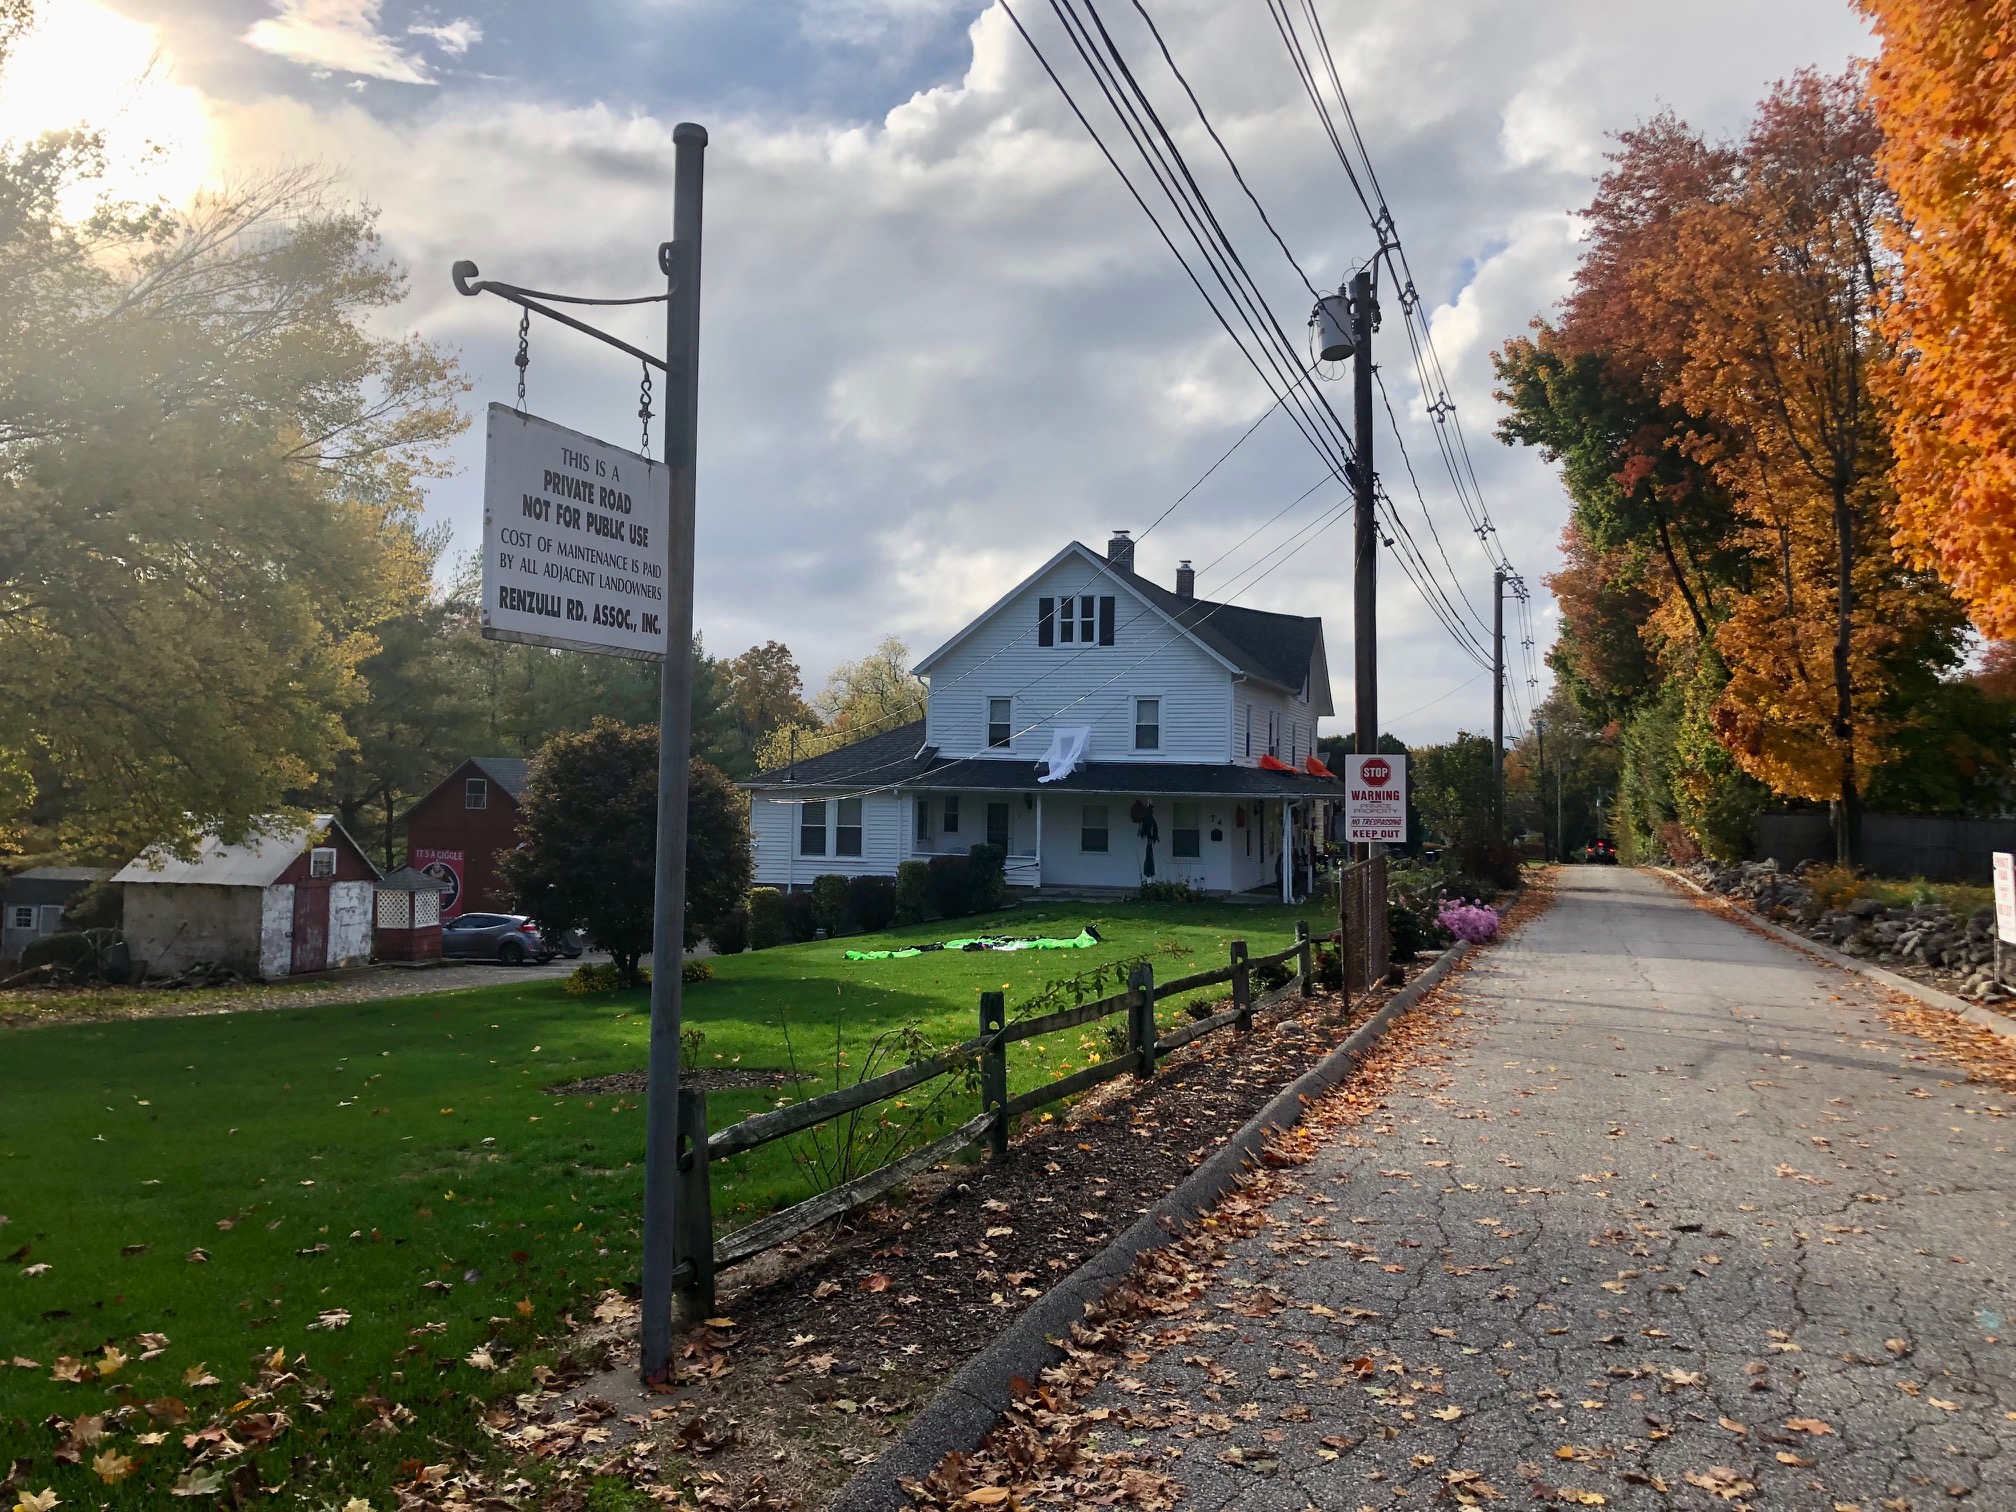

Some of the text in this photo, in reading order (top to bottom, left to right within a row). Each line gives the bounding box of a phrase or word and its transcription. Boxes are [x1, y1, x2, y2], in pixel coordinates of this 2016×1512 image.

[561, 447, 620, 482] THIS IS A
[543, 469, 632, 515] PRIVATE ROAD
[522, 493, 649, 548] NOT FOR PUBLIC USE
[501, 527, 662, 579] COST OF MAINTENANCE IS PAID
[500, 552, 662, 601] BY ALL ADJACENT LANDOWNERS
[499, 585, 662, 635] RENZULLI RD. ASSOC., INC.
[1363, 767, 1388, 778] STOP
[1351, 790, 1400, 801] WARNING
[1350, 818, 1402, 826] NO TRESPASSING
[1352, 829, 1400, 838] KEEP OUT
